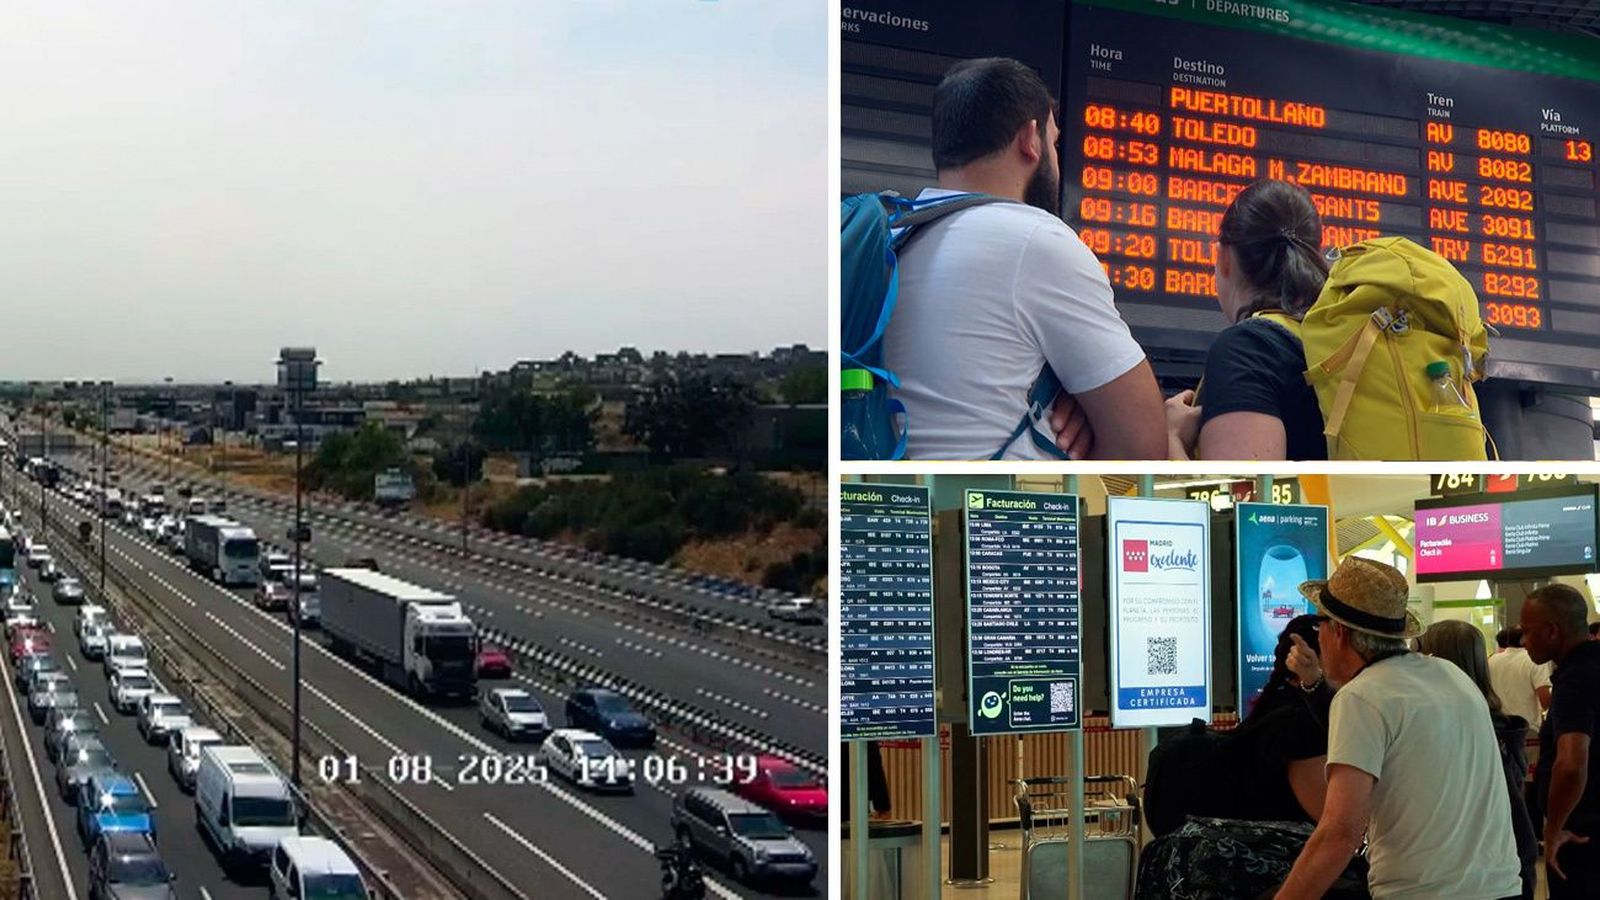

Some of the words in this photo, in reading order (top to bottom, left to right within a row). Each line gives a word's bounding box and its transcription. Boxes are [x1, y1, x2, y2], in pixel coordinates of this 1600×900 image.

[842, 7, 929, 31] ervaciones
[1206, 0, 1290, 23] DEPARTURES
[1090, 44, 1123, 61] Hora
[1090, 59, 1112, 71] TIME
[1173, 57, 1225, 75] Destino
[1172, 72, 1226, 87] DESTINATION
[1427, 92, 1454, 108] Tren
[1427, 107, 1451, 119] TRAIN
[1541, 107, 1562, 122] Vía
[1540, 122, 1580, 135] PLATFORM
[1085, 105, 1160, 135] 08:40
[1173, 116, 1257, 148] TOLEDO
[1427, 150, 1454, 172] AV
[1478, 156, 1532, 183] 8082
[1427, 121, 1454, 144] AV
[1477, 128, 1531, 154] 8080
[1565, 138, 1592, 162] 13
[1083, 135, 1159, 165] 08:53
[1169, 146, 1256, 177] MALAGA
[1268, 158, 1407, 196] M.ZAMBRANO
[1428, 178, 1469, 203] AVE
[1479, 185, 1534, 211] 2092
[1082, 166, 1158, 196] 09:00
[1429, 208, 1470, 233] AVE
[1481, 214, 1536, 240] 3091
[1080, 196, 1157, 228] 09:16
[1482, 243, 1537, 270] 6291
[1079, 228, 1156, 258] 09:20
[1484, 272, 1539, 299] 8292
[1486, 302, 1542, 329] 3093
[891, 494, 921, 503] Check-in
[986, 497, 1036, 510] Facturación
[1043, 502, 1070, 510] Check-in
[1258, 515, 1276, 523] aena
[1280, 515, 1302, 526] parking
[1426, 516, 1437, 527] IB
[1449, 512, 1488, 524] BUSINESS
[1420, 538, 1452, 548] Facturación
[1246, 654, 1268, 663] Volver
[1012, 694, 1028, 702] need
[1028, 692, 1045, 703] help?
[1022, 686, 1034, 694] you
[1140, 688, 1185, 697] EMPRESA
[1129, 698, 1196, 707] CERTIFICADA
